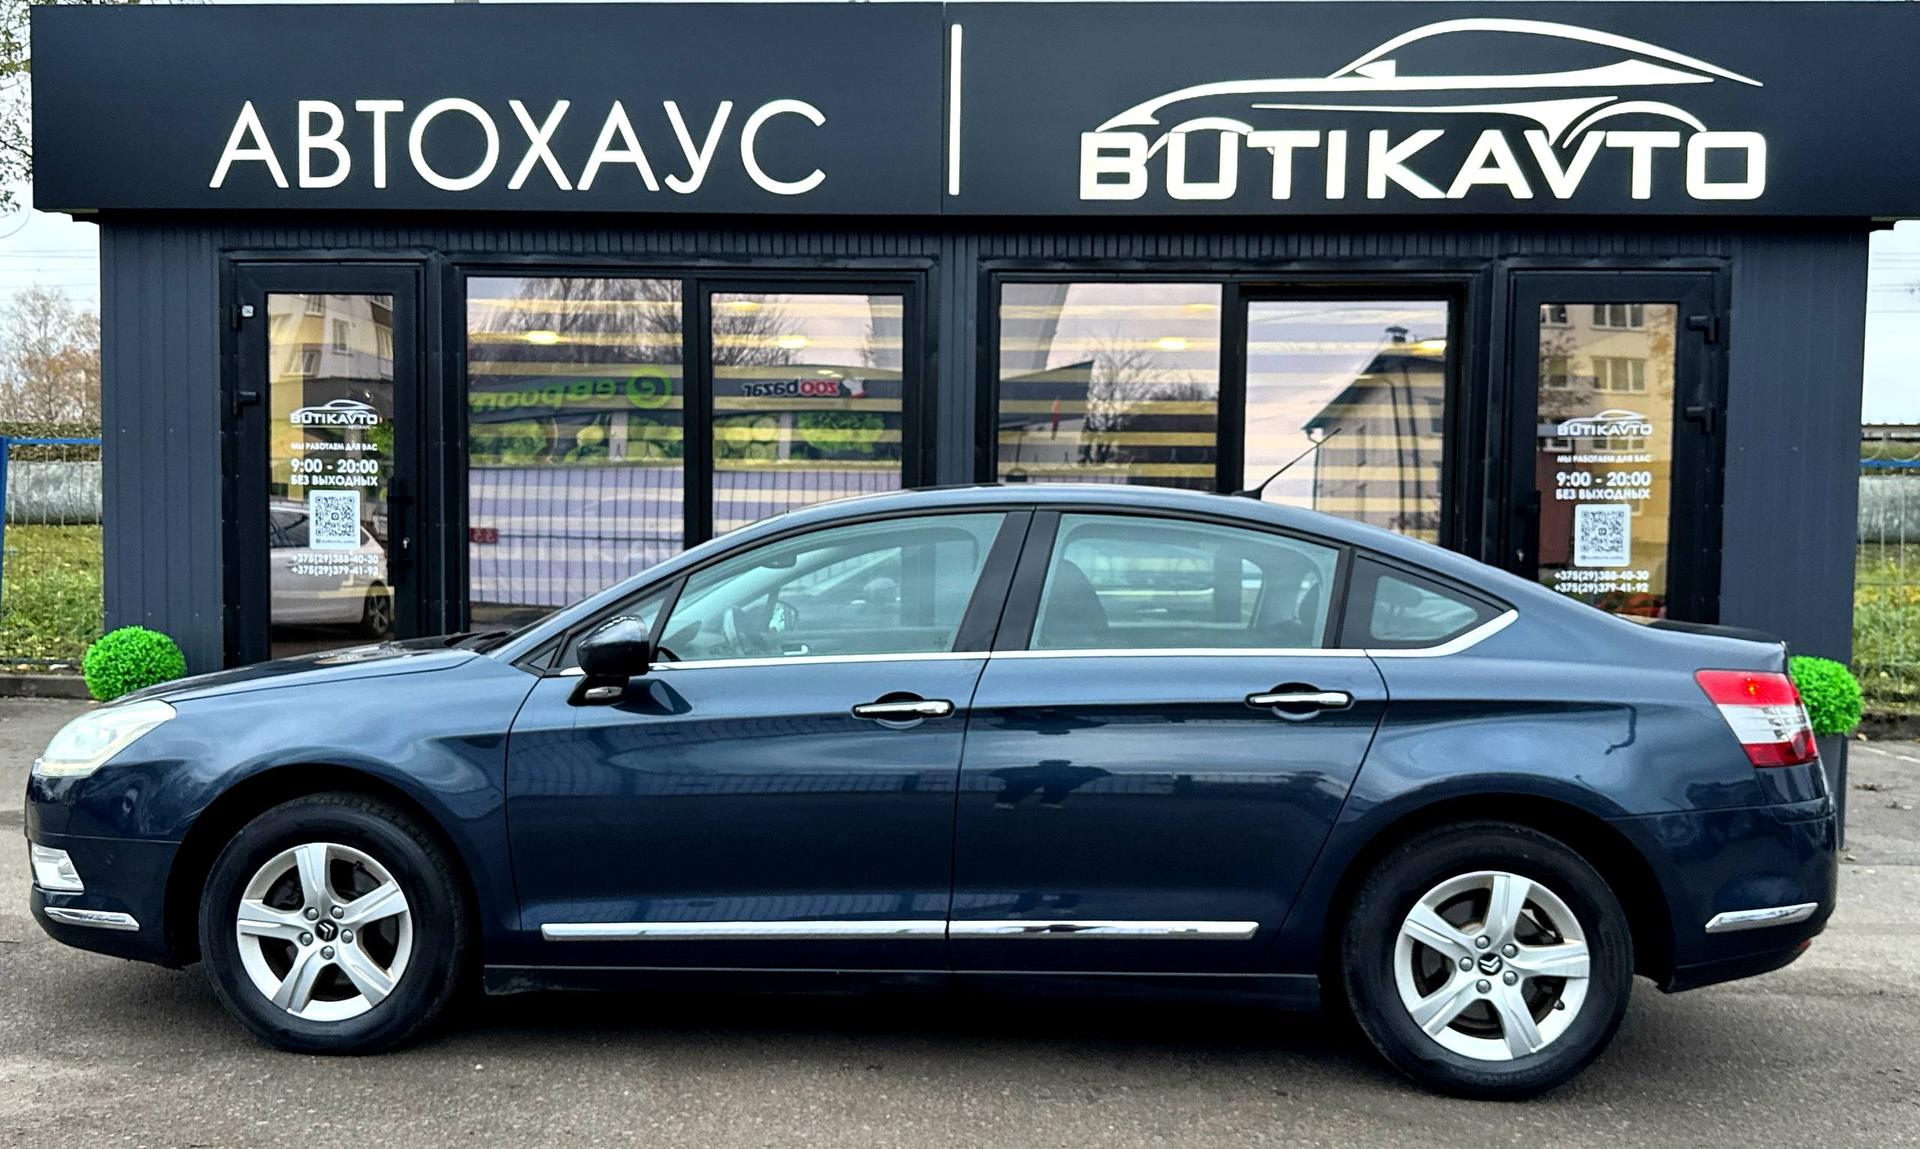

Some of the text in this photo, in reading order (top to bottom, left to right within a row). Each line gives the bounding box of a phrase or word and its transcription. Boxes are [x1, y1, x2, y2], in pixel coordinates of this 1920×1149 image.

[208, 97, 827, 195] АВТОХАУС
[1079, 127, 1767, 201] BUTIKAVTO
[290, 412, 379, 425] BUTIKAVTO
[1557, 423, 1653, 436] BUTIKAVTO
[306, 442, 344, 451] РАБОТАЕМ
[361, 443, 378, 452] ВАС
[290, 458, 323, 473] 9:00
[337, 458, 379, 474] 20:00
[290, 474, 379, 487] БЕЗ ВЫХОДНЫХ
[1555, 471, 1591, 487] 9:00
[1605, 471, 1653, 487] 20:00
[1555, 488, 1651, 502] БЕЗ ВЫХОДНЫХ
